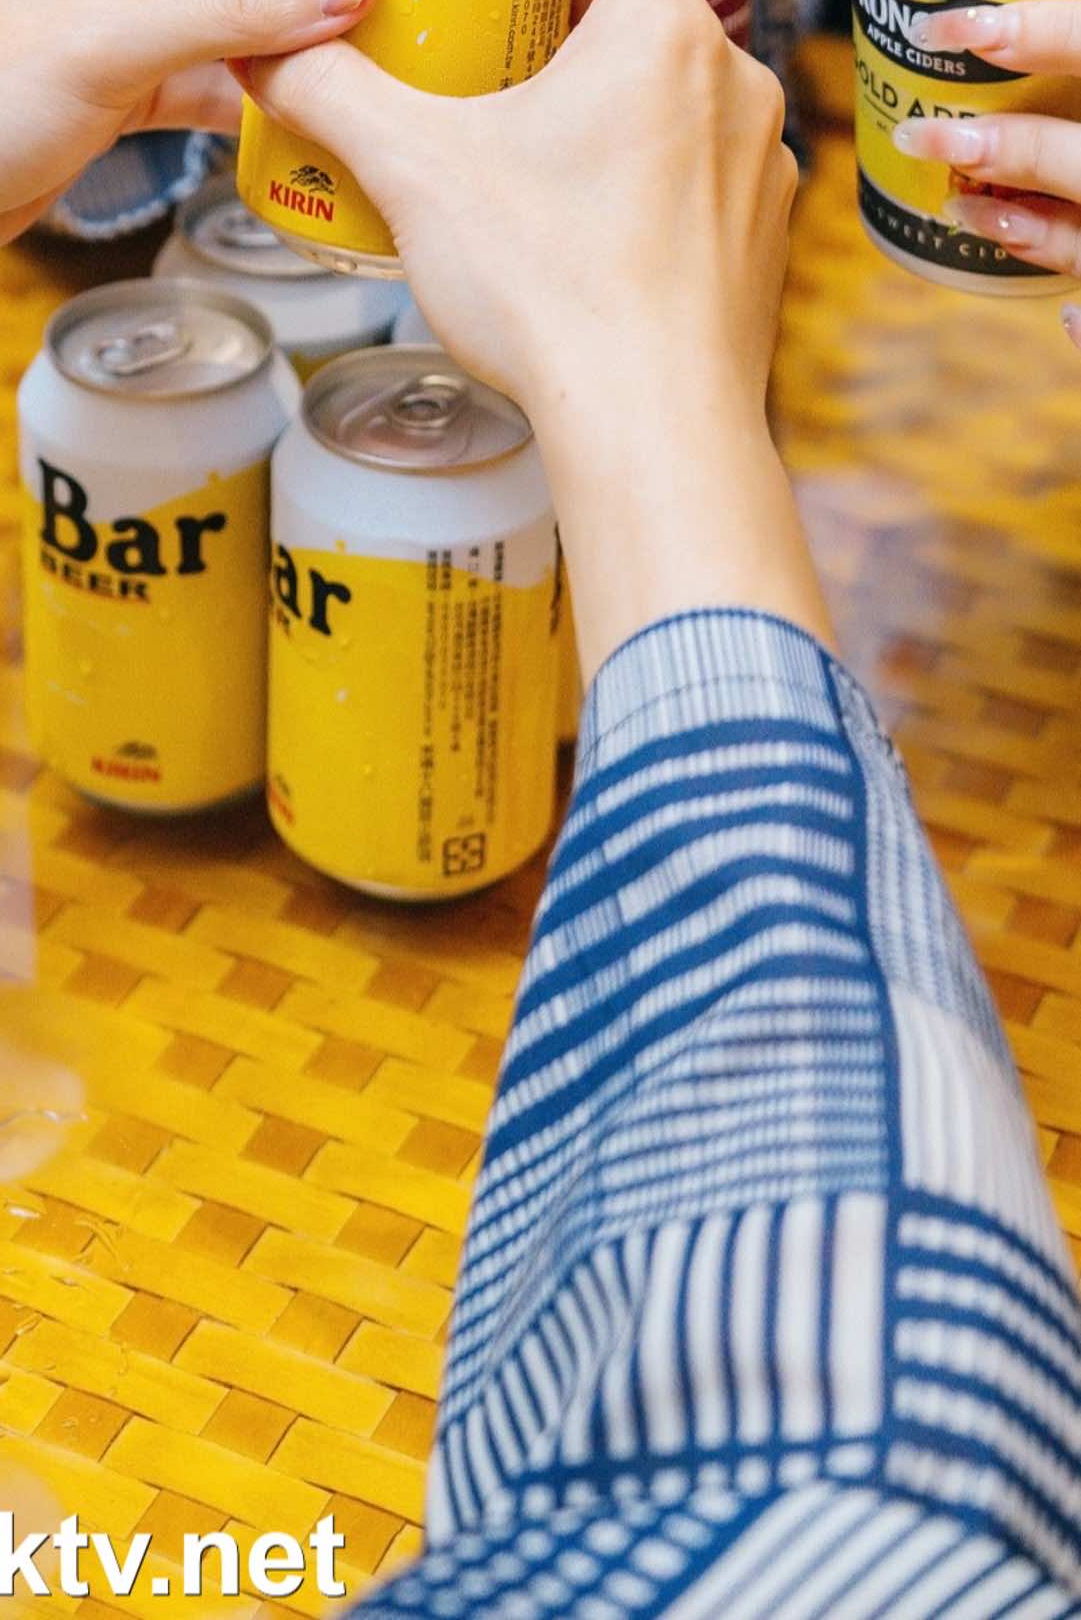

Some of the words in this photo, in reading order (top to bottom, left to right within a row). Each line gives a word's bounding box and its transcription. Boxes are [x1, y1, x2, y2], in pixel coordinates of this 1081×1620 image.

[867, 23, 904, 58] APPLE
[905, 47, 968, 77] CIDERS
[855, 59, 899, 109] OLD
[269, 180, 335, 223] KIRIN
[958, 243, 1009, 261] CID
[37, 452, 227, 576] Bar
[272, 543, 352, 637] ar
